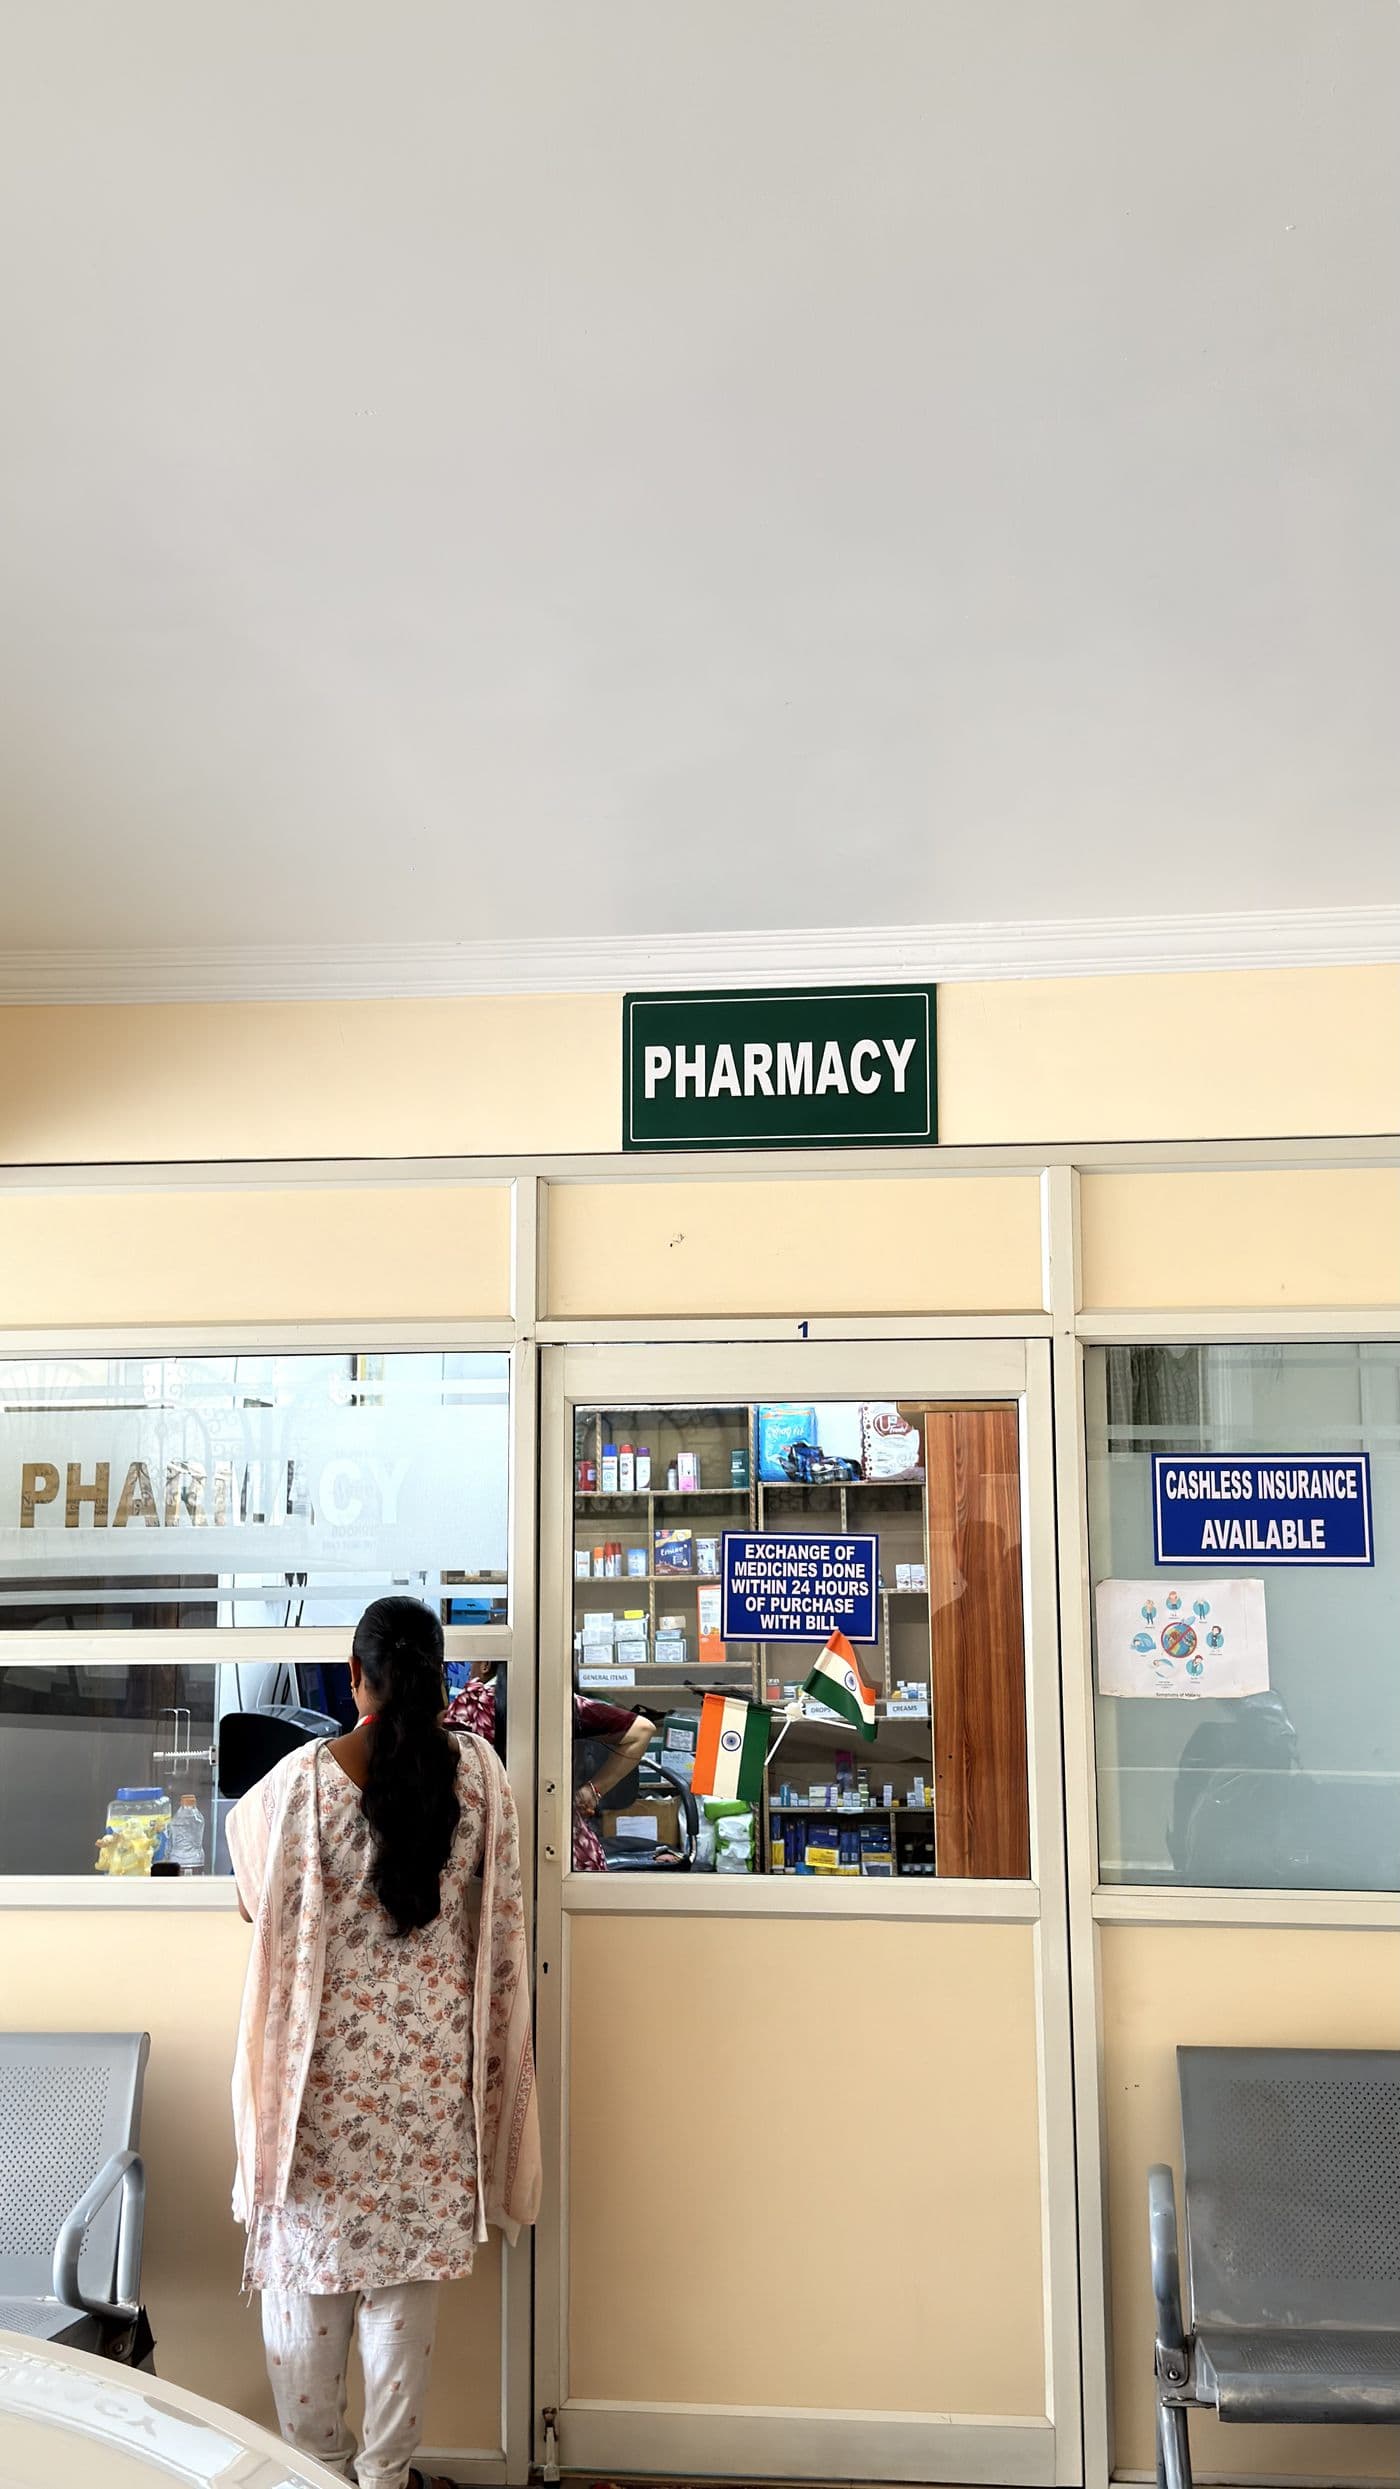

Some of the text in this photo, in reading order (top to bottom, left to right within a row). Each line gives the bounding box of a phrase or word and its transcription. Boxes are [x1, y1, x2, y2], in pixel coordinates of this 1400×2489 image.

[645, 1039, 917, 1099] PHARMACY
[797, 1321, 809, 1338] 1
[20, 1458, 411, 1528] PHARMACY
[1165, 1469, 1358, 1500] CASHLESS INSURANCE
[1201, 1519, 1326, 1550] AVAILABLE
[745, 1544, 855, 1560] EXCHANGE OF
[734, 1561, 865, 1579] MEDICINES DONE
[731, 1579, 869, 1596] WITHIN 24 HOURS
[745, 1597, 854, 1613] OF PURCHASE
[760, 1614, 839, 1630] WITH BILL
